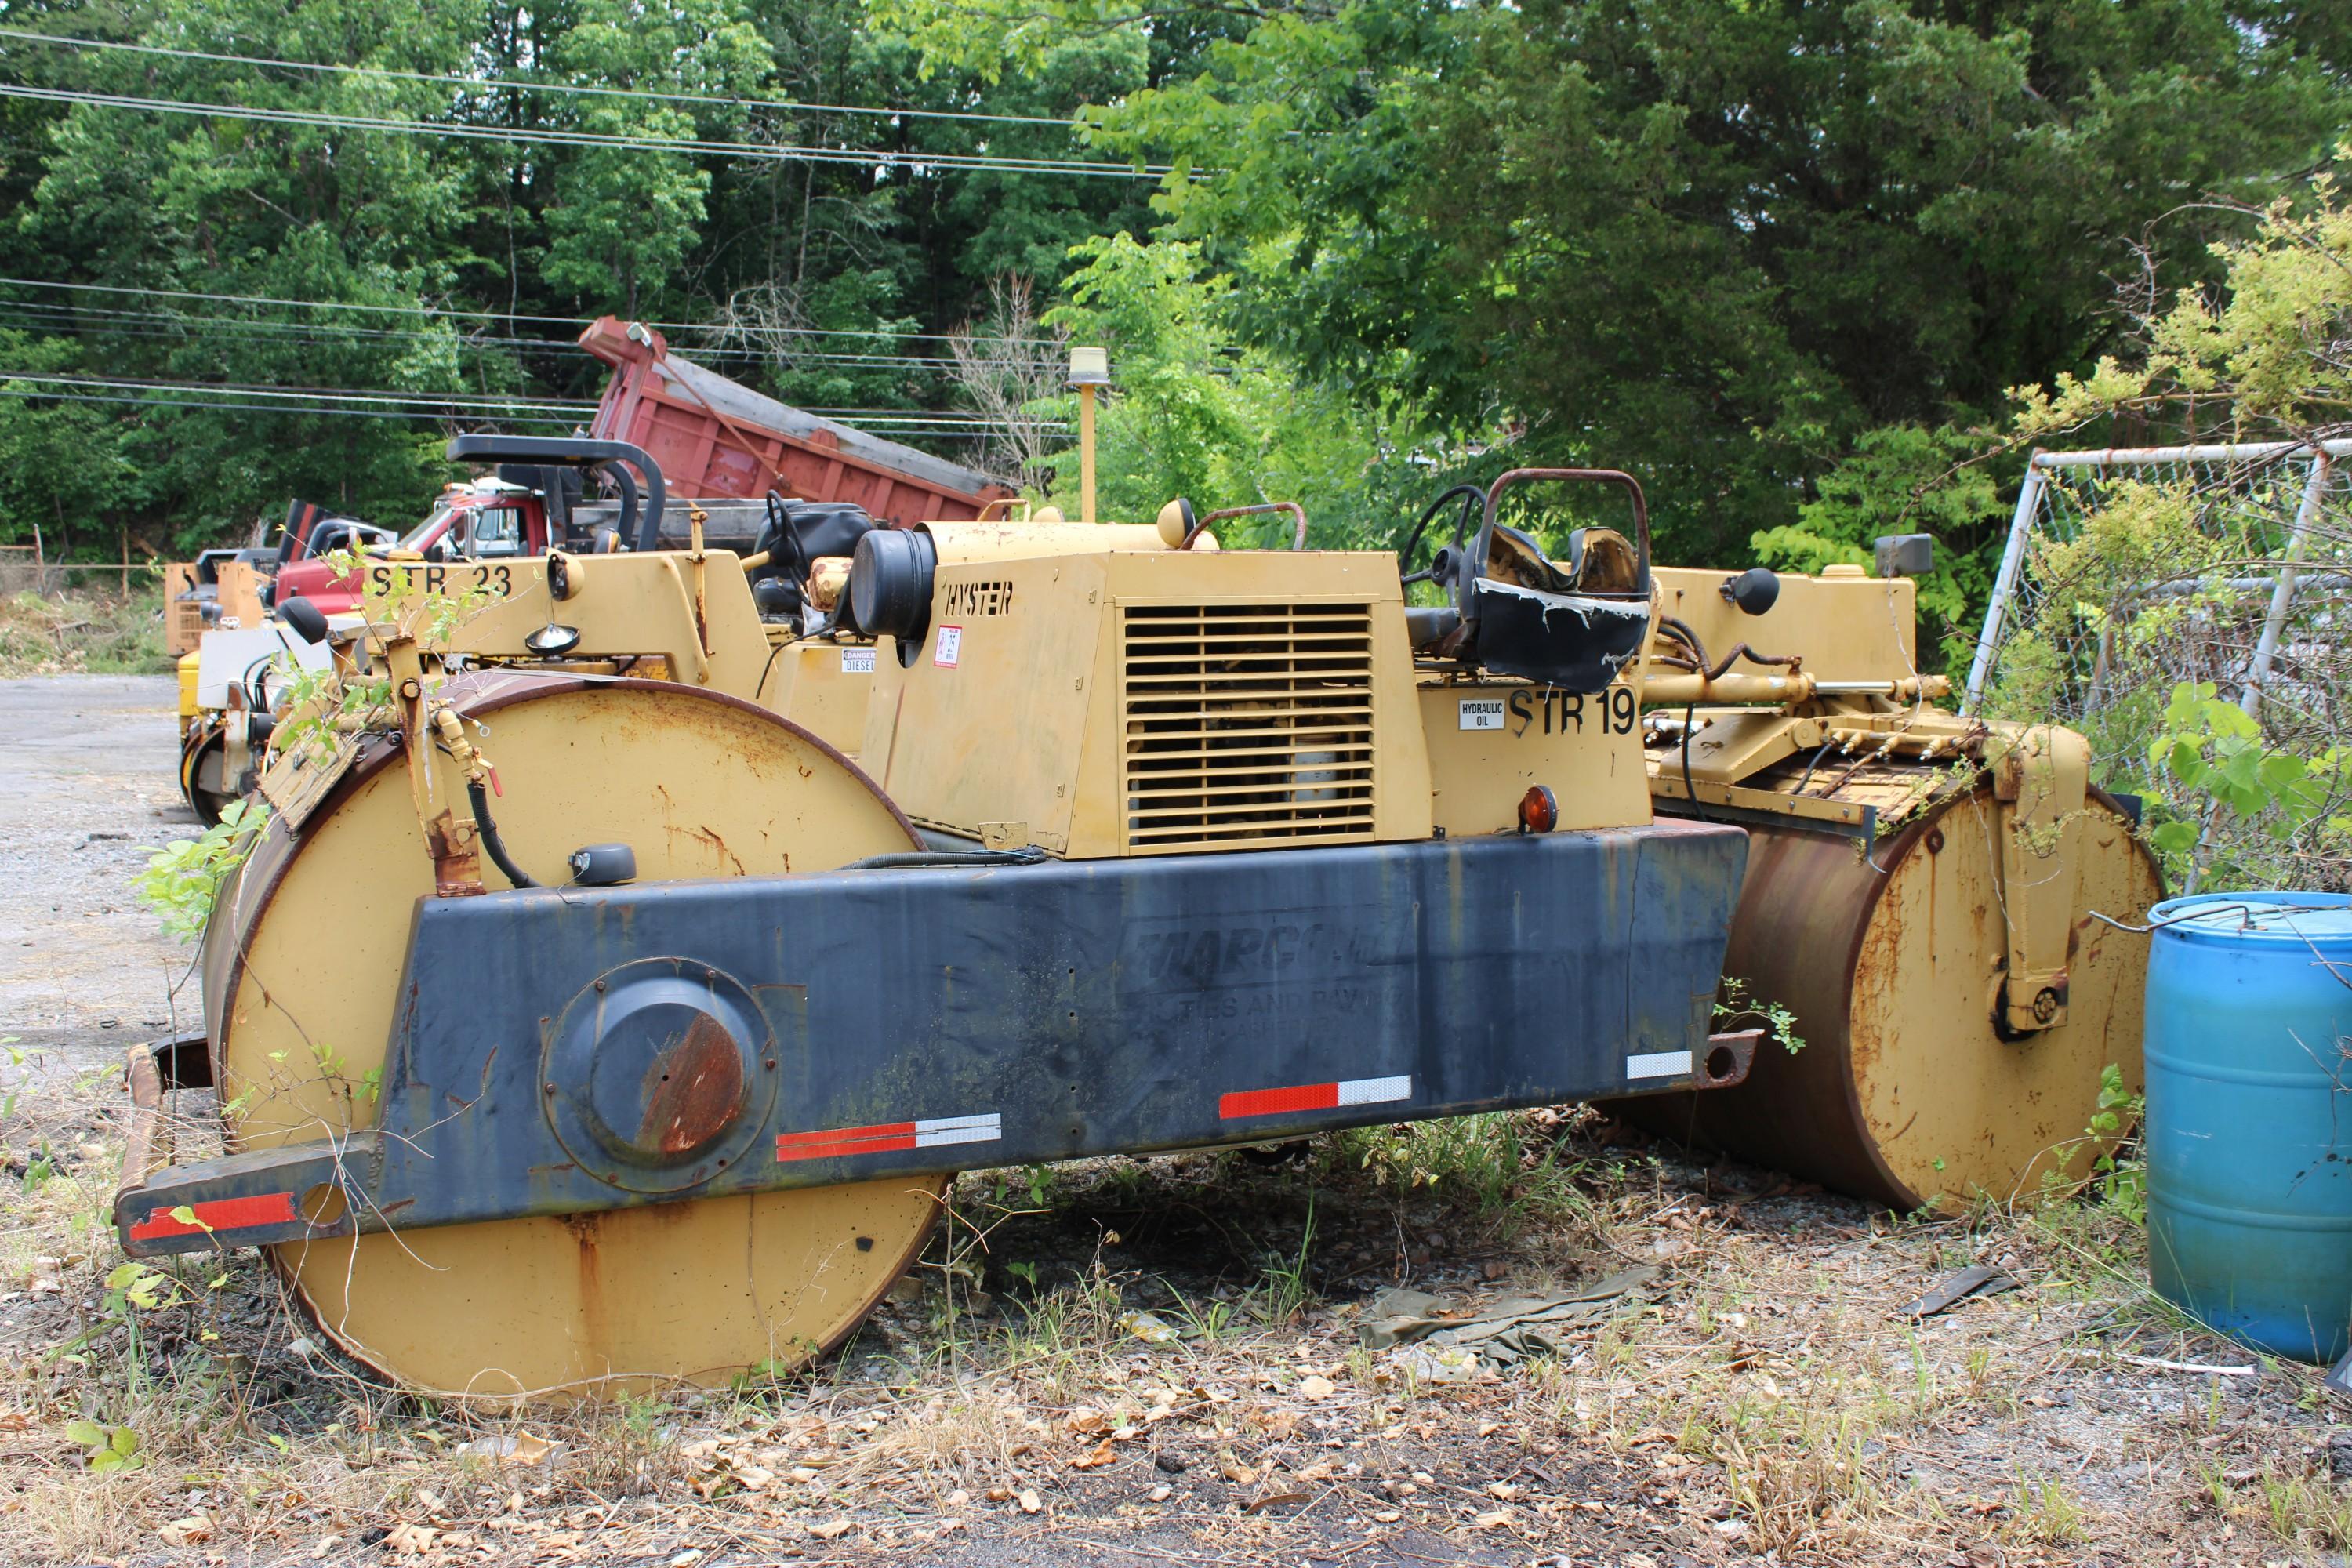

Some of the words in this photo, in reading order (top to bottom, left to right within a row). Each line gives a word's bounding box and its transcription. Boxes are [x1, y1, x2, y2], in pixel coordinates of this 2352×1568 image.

[373, 566, 446, 597] STR
[472, 565, 511, 597] 23
[945, 581, 1013, 616] HYSTER
[847, 660, 874, 671] DIESEL
[1462, 702, 1502, 714] HYDRAULIC
[1509, 689, 1584, 738] STR
[1595, 688, 1635, 735] 19
[1476, 716, 1488, 727] OIL
